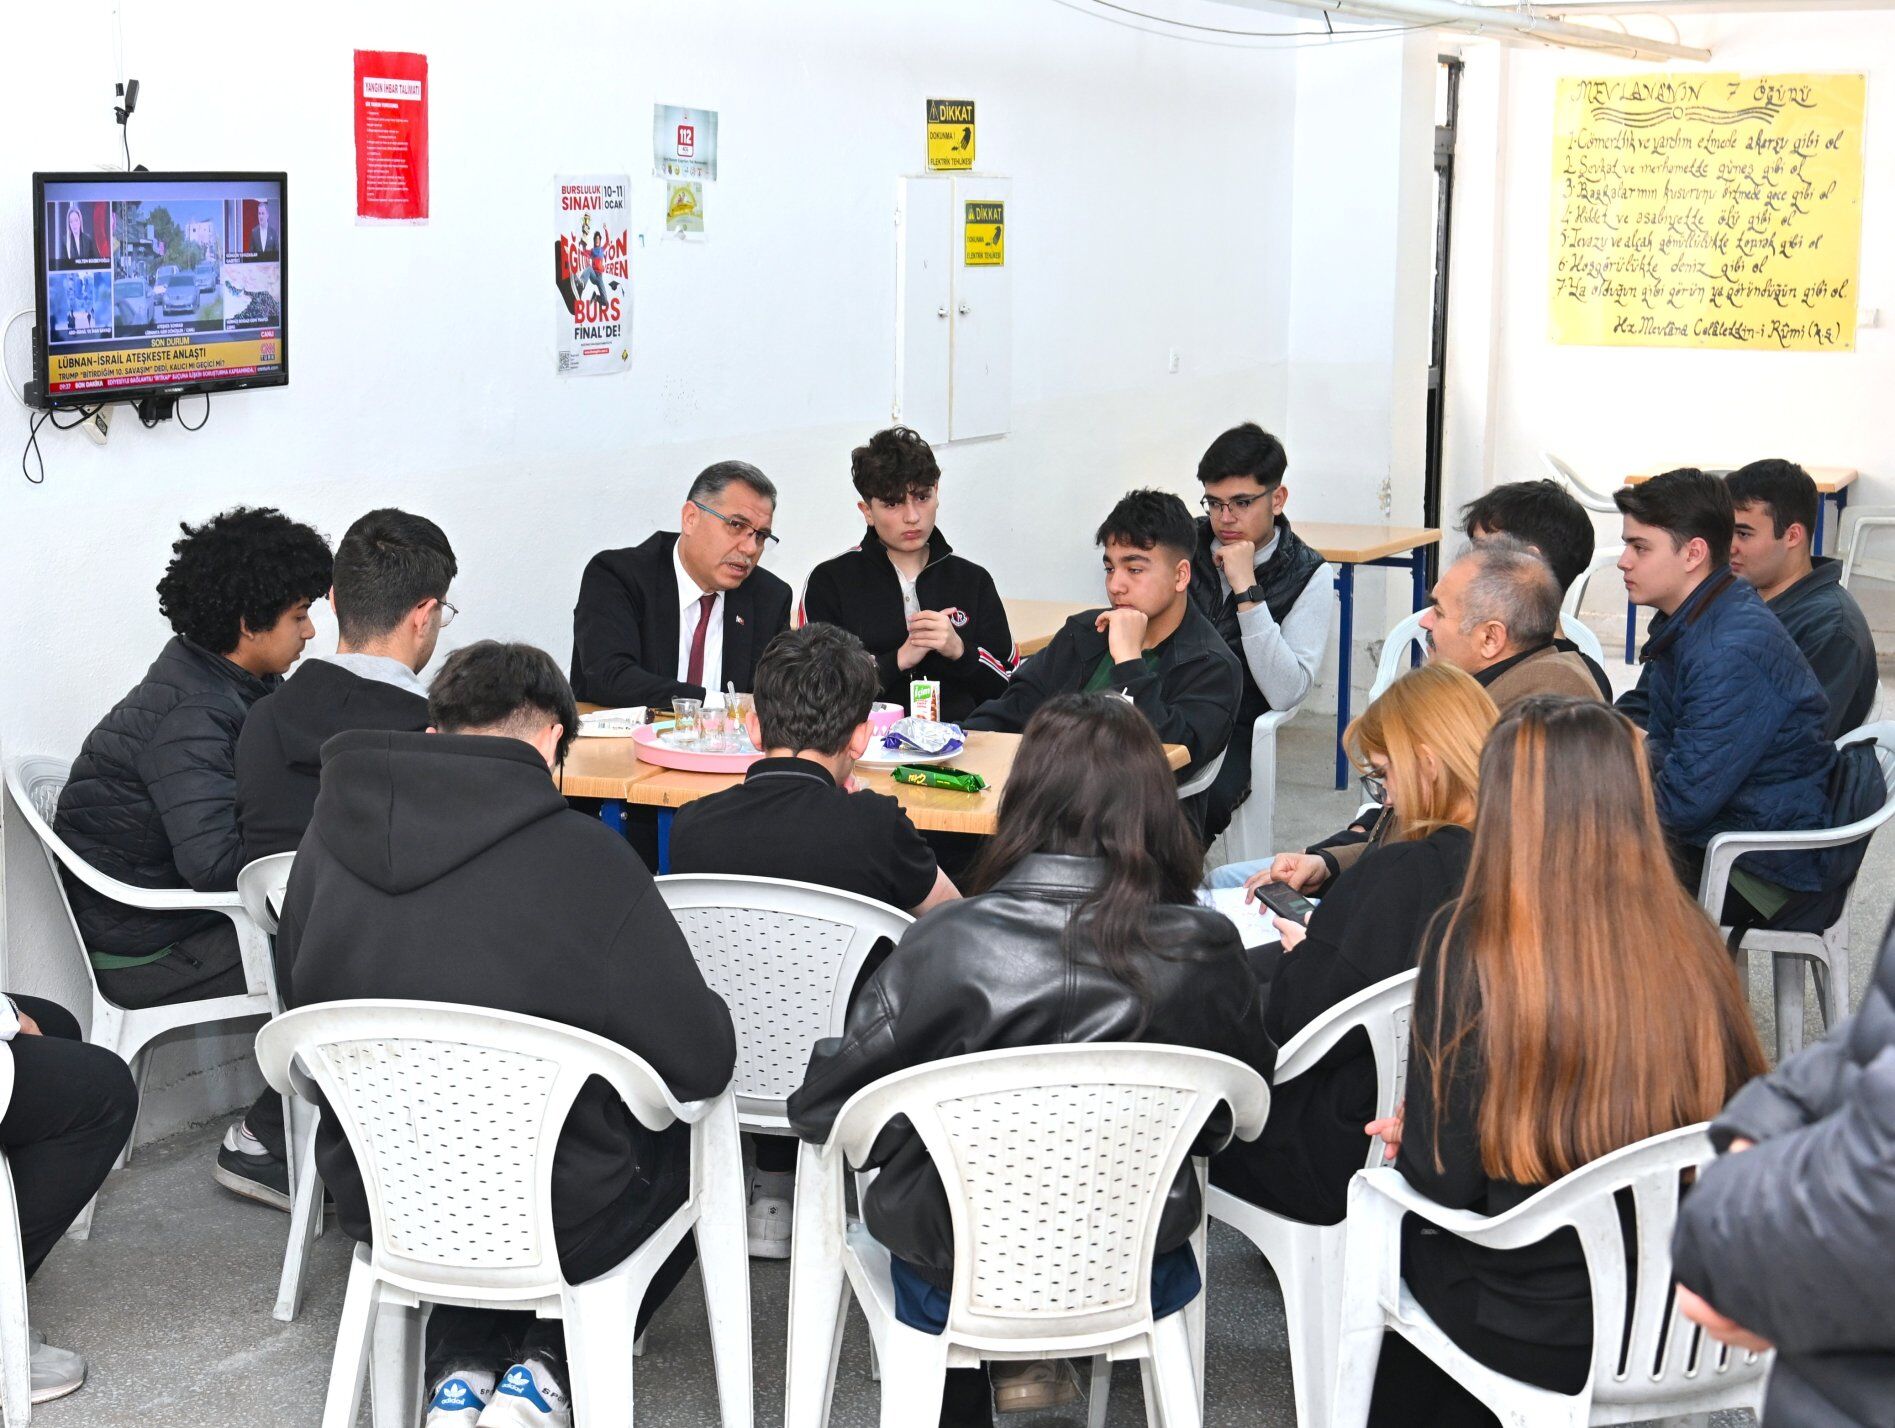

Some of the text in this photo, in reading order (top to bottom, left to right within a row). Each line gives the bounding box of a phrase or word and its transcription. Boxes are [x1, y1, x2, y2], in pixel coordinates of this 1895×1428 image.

[1727, 82, 1740, 100] 7
[940, 102, 972, 121] DİKKAT
[680, 128, 692, 145] 112
[930, 131, 953, 140] DOKUNMA
[1790, 130, 1819, 157] gibi
[1825, 130, 1844, 150] ol
[561, 185, 601, 195] BURSLULUK
[604, 185, 623, 197] 10-11
[562, 196, 602, 210] SINAVI
[604, 200, 623, 209] OCAK
[976, 205, 1001, 220] DİKKAT
[1752, 255, 1768, 273] ol
[574, 298, 621, 324] BURS
[574, 324, 621, 340] FİNAL'DE!
[151, 337, 190, 347] SON DURUM
[58, 348, 206, 369] LÜBNAN-İSRAİL ATEŞKESTE ANLAŞTI
[58, 372, 79, 381] TRUMP
[170, 362, 187, 370] KALICI
[196, 360, 216, 369] GEÇİCİ
[501, 1382, 525, 1394] adidas
[441, 1397, 465, 1406] adidas
